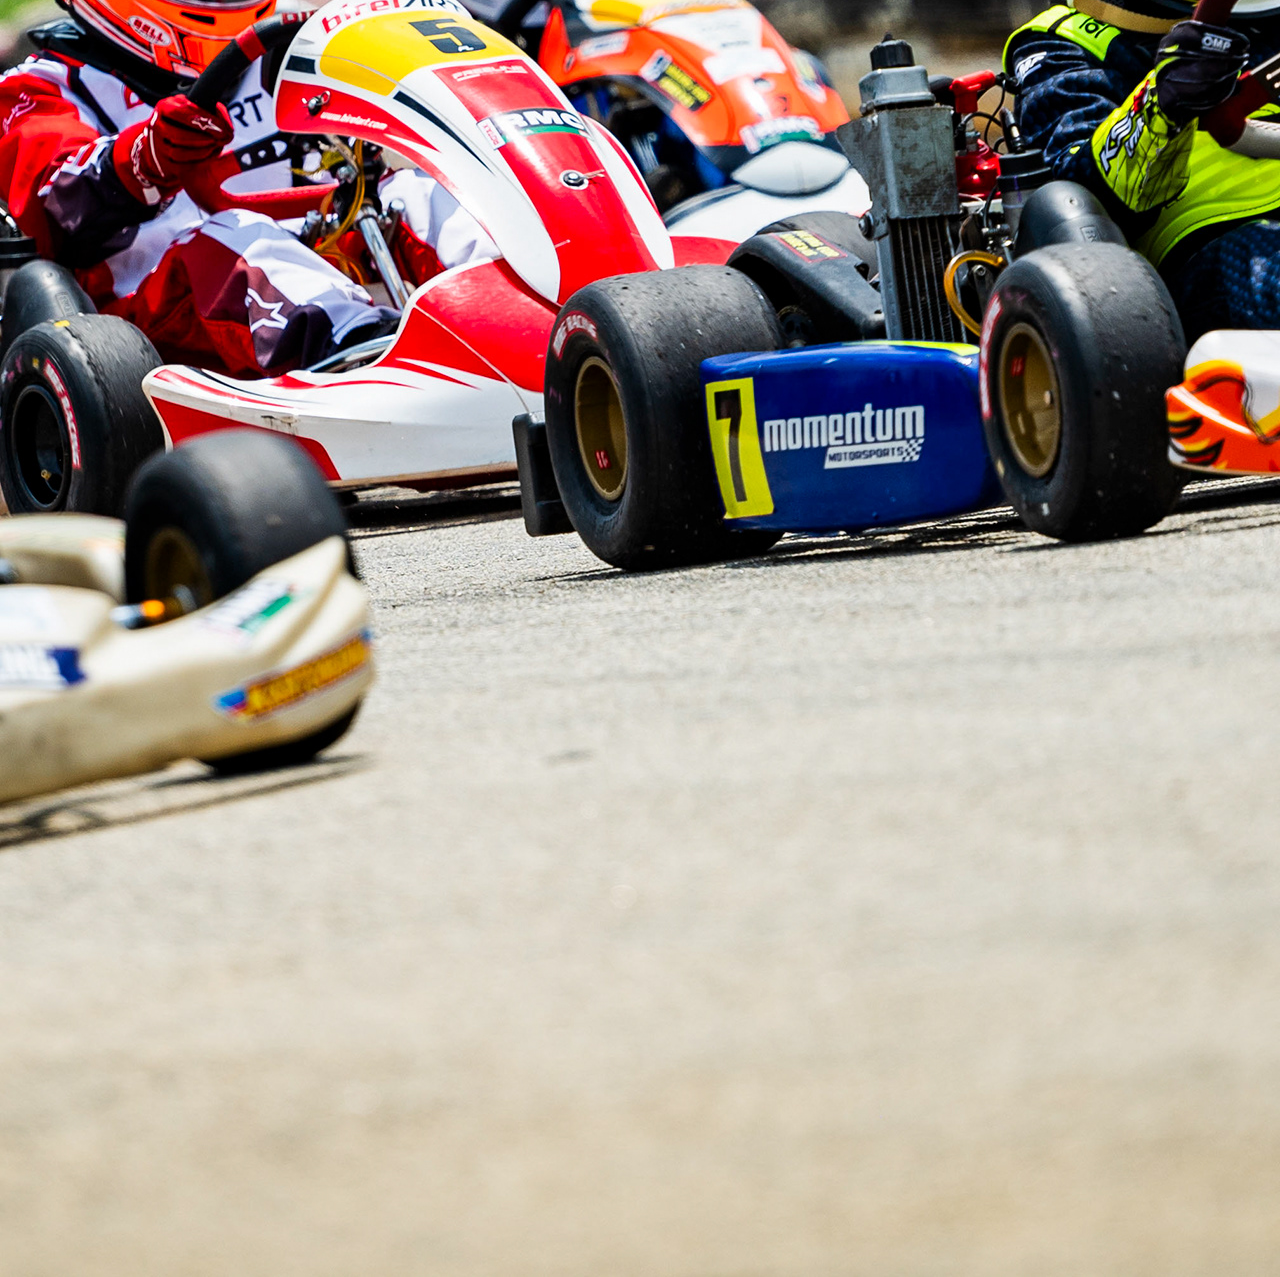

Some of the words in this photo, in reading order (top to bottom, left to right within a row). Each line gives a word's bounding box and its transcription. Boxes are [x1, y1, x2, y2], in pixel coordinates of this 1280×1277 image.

[133, 16, 165, 43] BELL
[408, 18, 487, 54] 5
[1201, 34, 1232, 50] OMP
[226, 93, 263, 127] RT
[763, 403, 925, 452] momentum
[714, 389, 748, 503] 7
[828, 446, 905, 463] MOTORSPORTS
